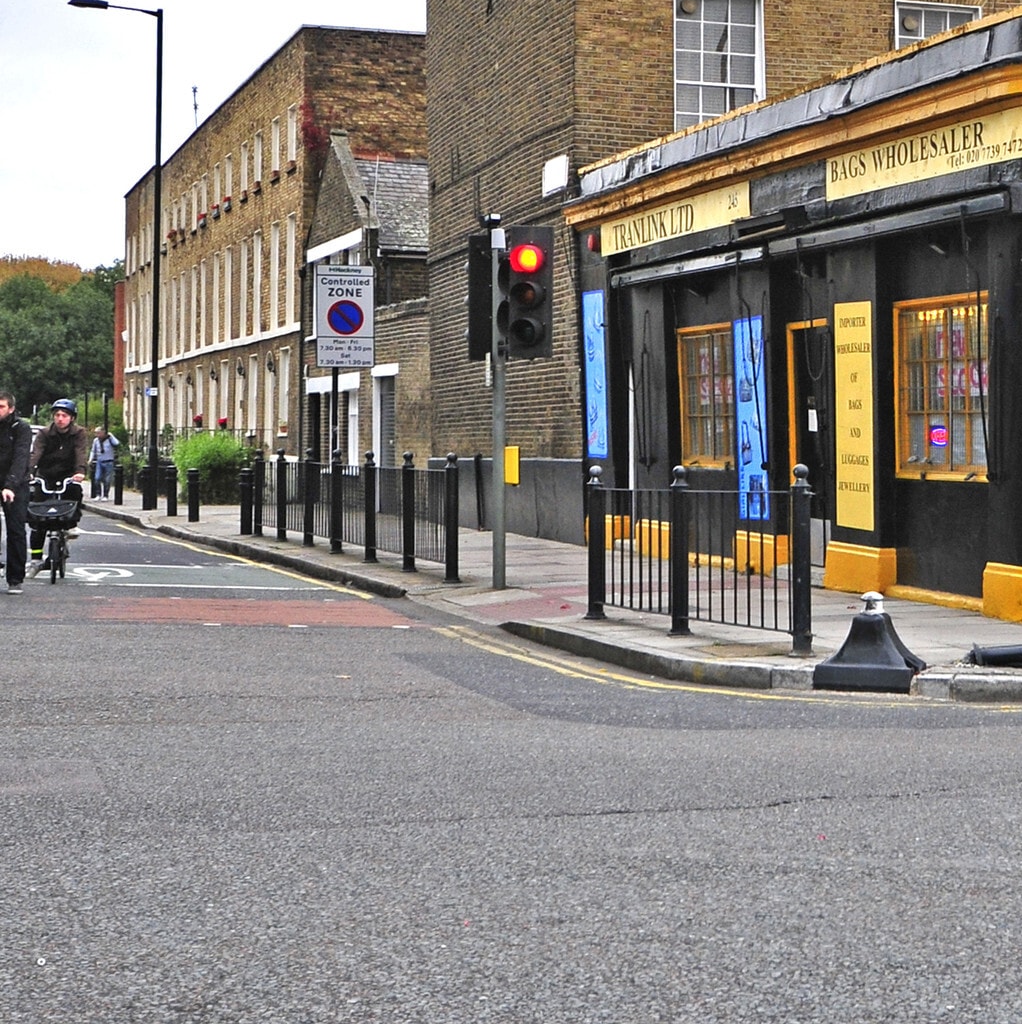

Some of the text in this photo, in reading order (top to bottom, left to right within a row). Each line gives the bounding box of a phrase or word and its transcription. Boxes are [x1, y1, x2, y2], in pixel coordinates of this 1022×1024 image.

[831, 121, 984, 183] BAGS WHOLESALER
[950, 138, 1022, 168] Tel: 020 7739 7472
[613, 210, 668, 251] TRANLINK
[670, 203, 694, 236] LTD
[320, 277, 370, 286] Controlled
[327, 287, 363, 297] ZONE
[850, 372, 859, 383] OF
[848, 400, 862, 410] BAGS
[850, 427, 862, 439] AND
[841, 454, 870, 466] LUGGAGES
[838, 481, 870, 493] JEWELLERY
